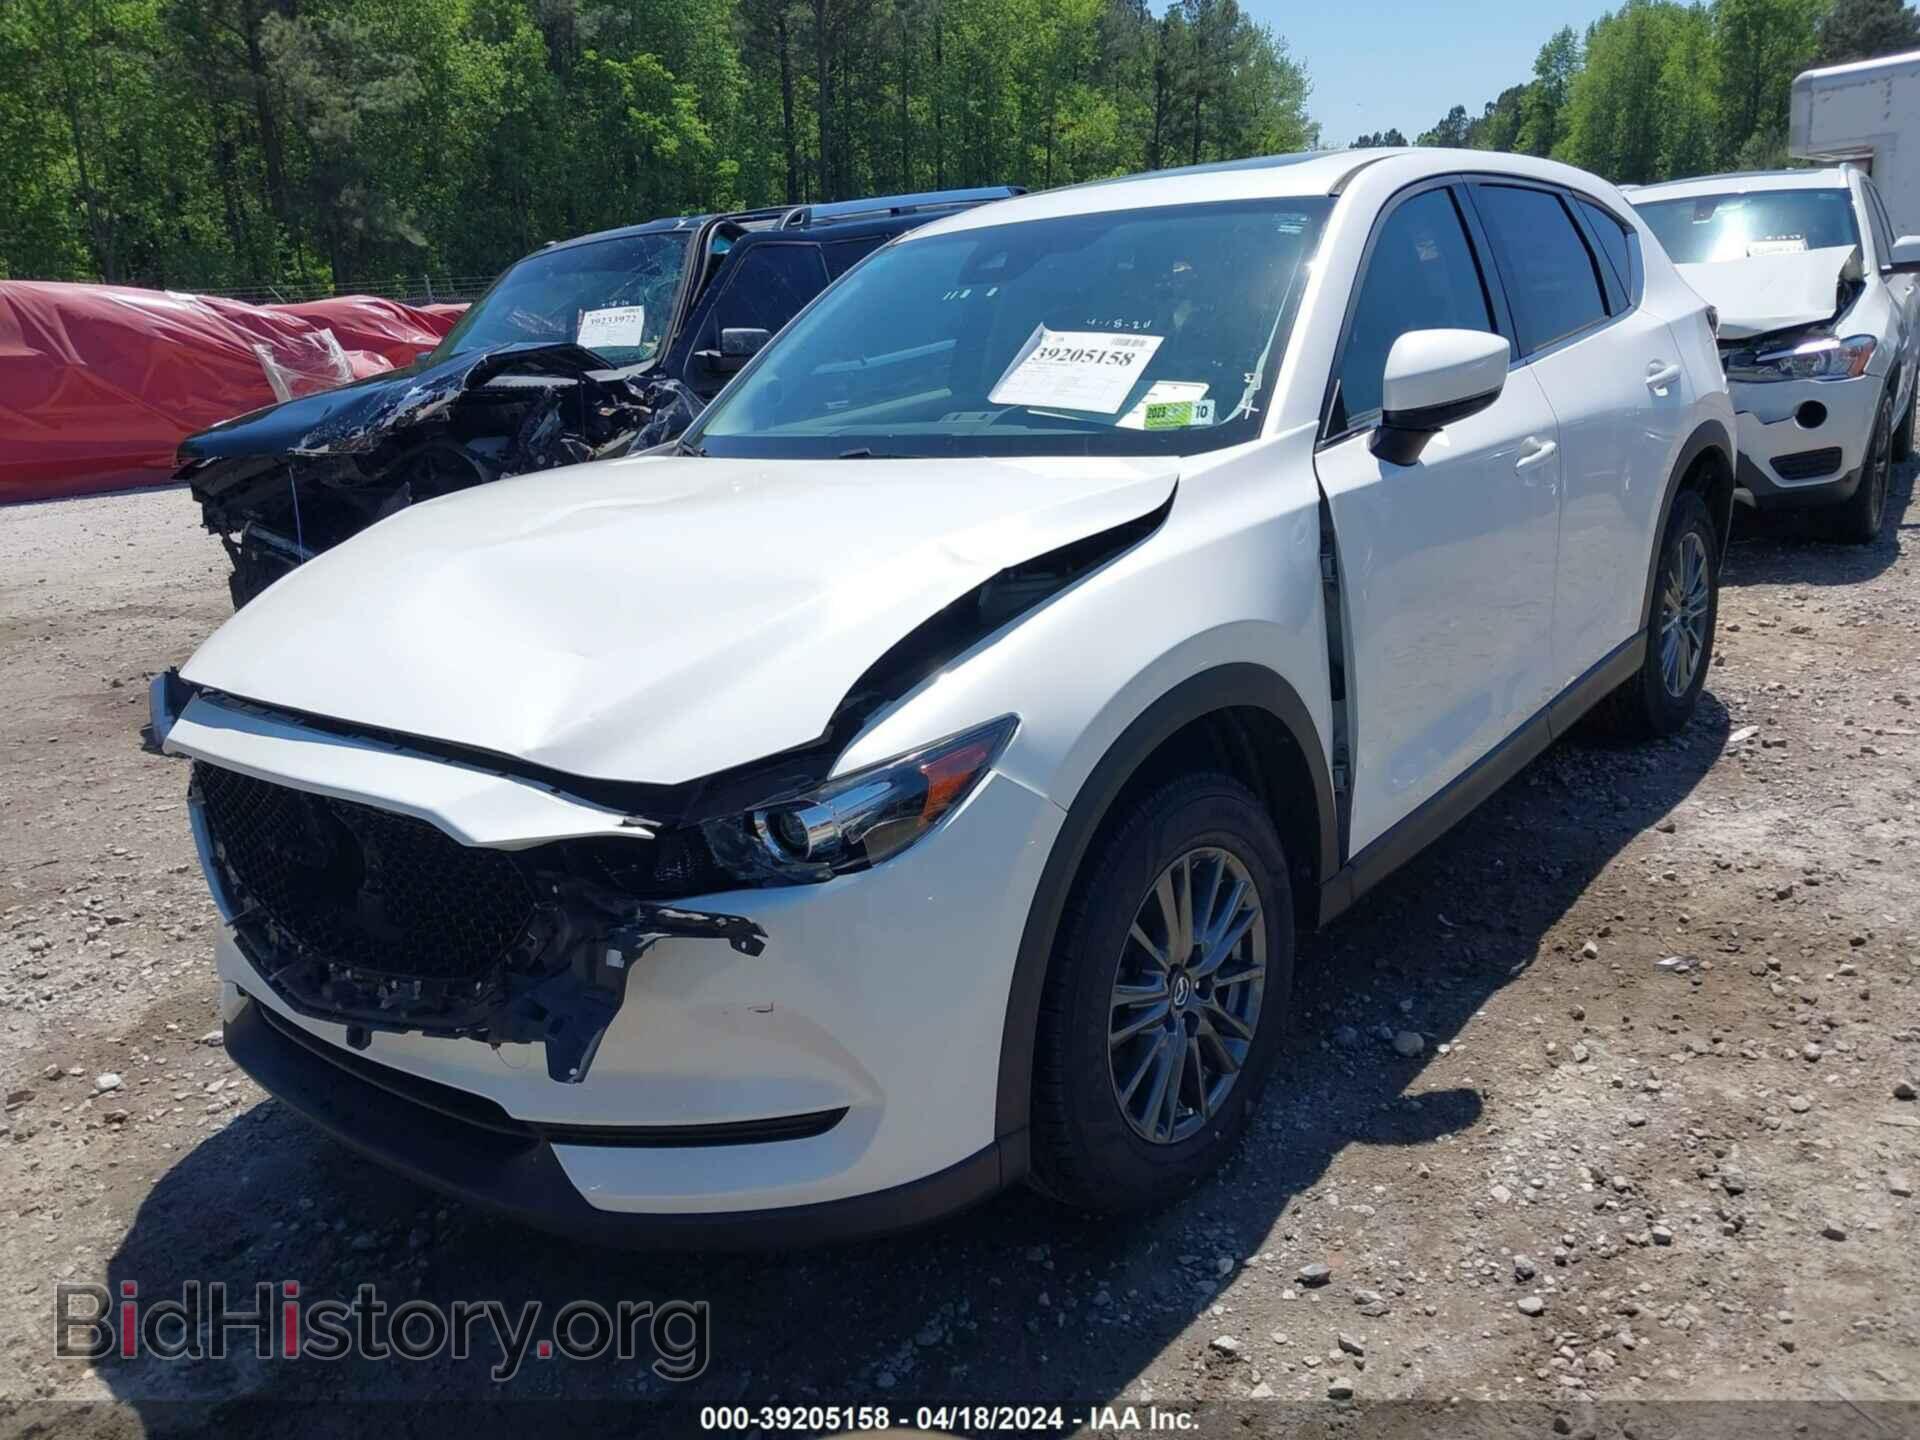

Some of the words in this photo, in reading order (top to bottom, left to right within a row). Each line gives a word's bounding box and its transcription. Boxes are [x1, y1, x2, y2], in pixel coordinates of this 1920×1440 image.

[1033, 347, 1136, 367] 39205158
[1147, 406, 1167, 419] 2023
[1195, 405, 1208, 418] 10
